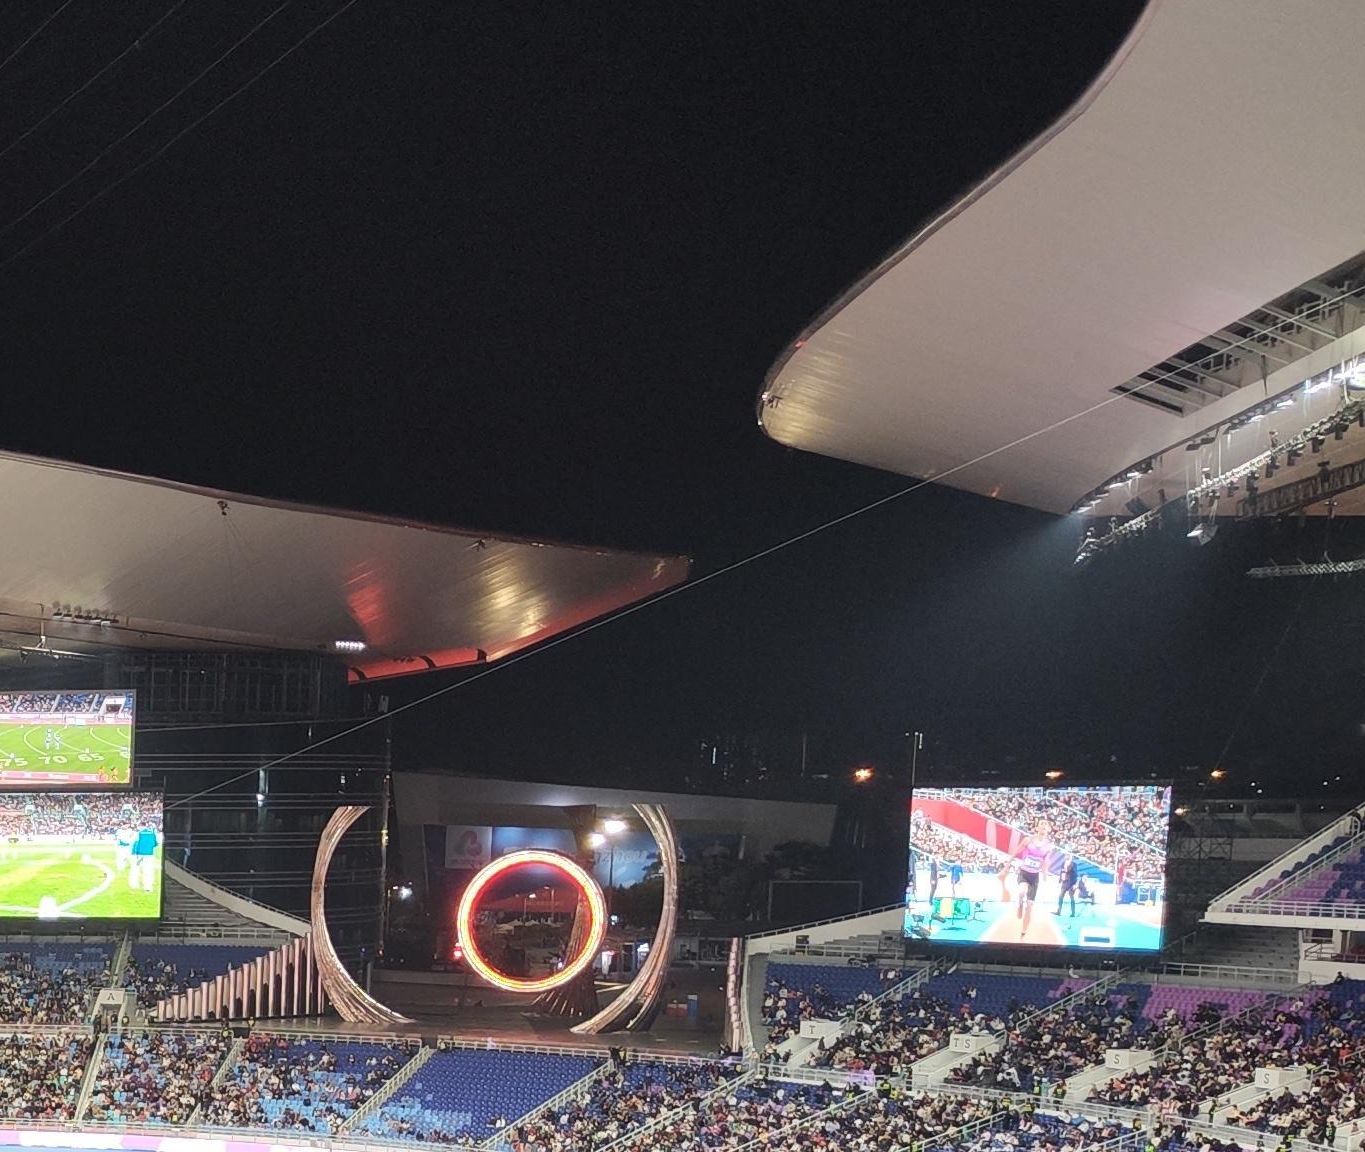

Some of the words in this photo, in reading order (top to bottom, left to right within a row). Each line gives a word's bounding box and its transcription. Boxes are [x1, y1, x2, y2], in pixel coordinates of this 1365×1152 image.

[107, 992, 116, 1001] A
[1113, 1054, 1120, 1064] S
[1263, 1073, 1270, 1084] S
